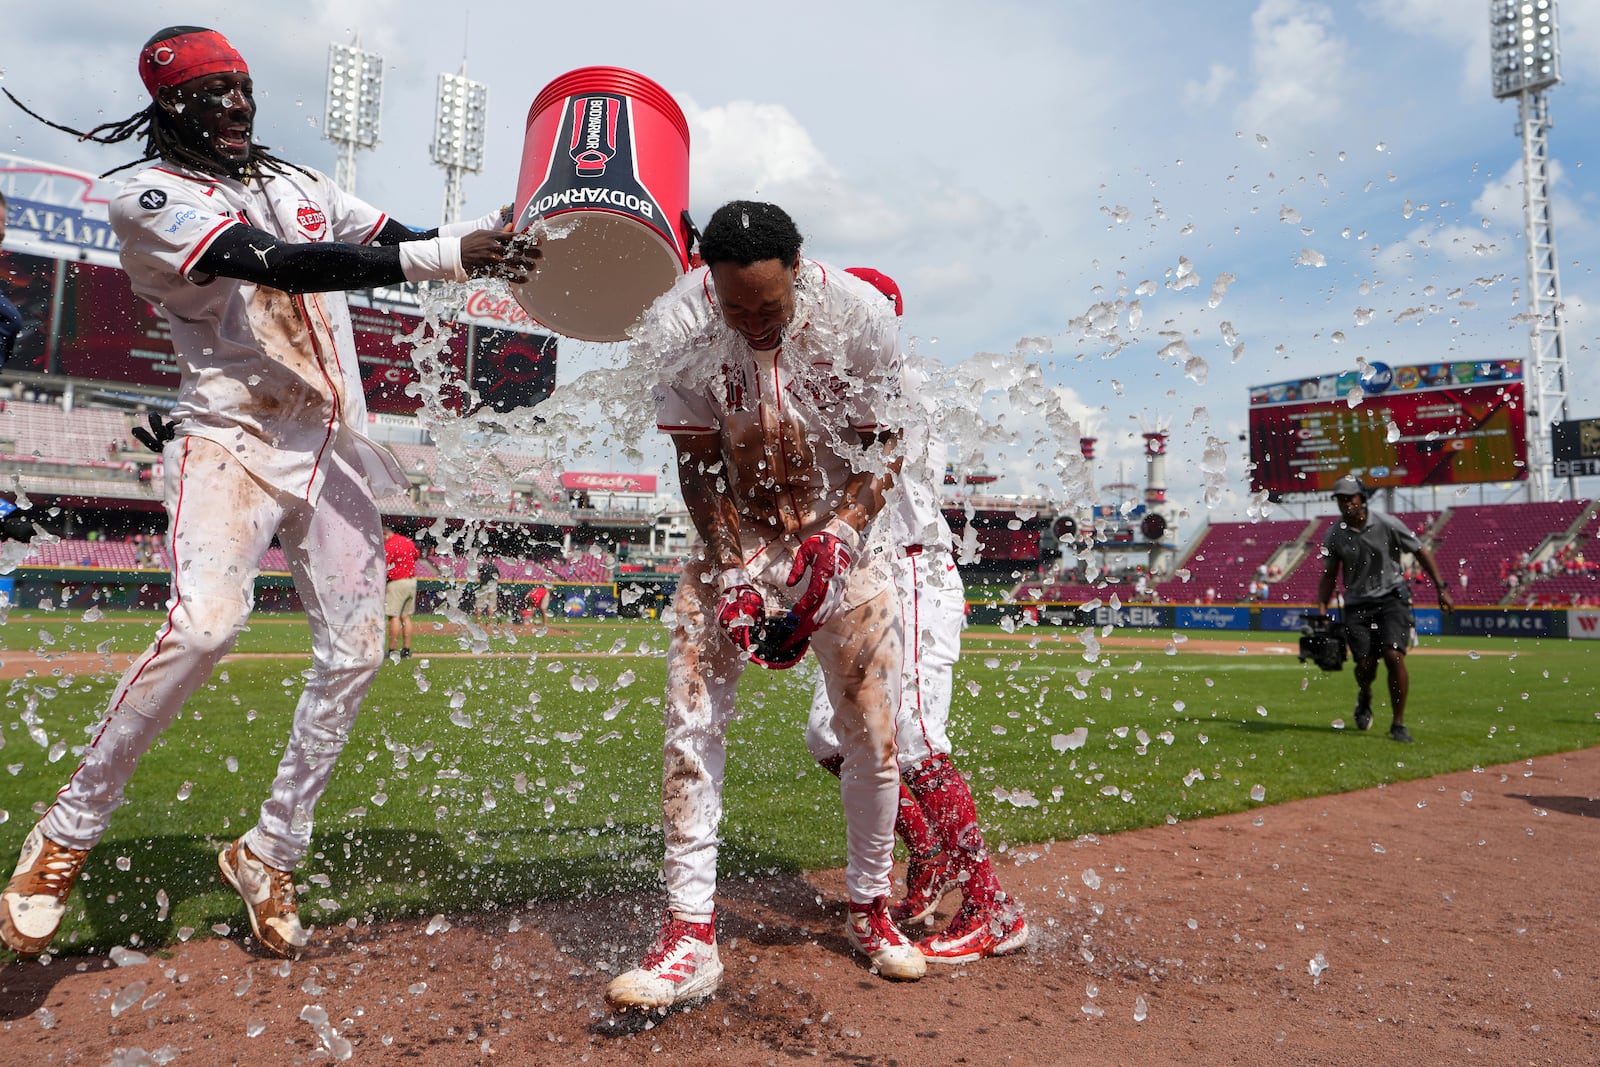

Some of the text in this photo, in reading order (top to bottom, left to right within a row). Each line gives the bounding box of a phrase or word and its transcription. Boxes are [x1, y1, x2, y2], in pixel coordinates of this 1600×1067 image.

[154, 46, 175, 65] C
[586, 99, 604, 150] BODYARMOR
[142, 191, 164, 208] 14
[527, 187, 654, 220] BODYARMOR
[298, 212, 325, 227] REDS
[380, 416, 415, 426] TOYOTA
[1460, 615, 1544, 630] MEDPACE
